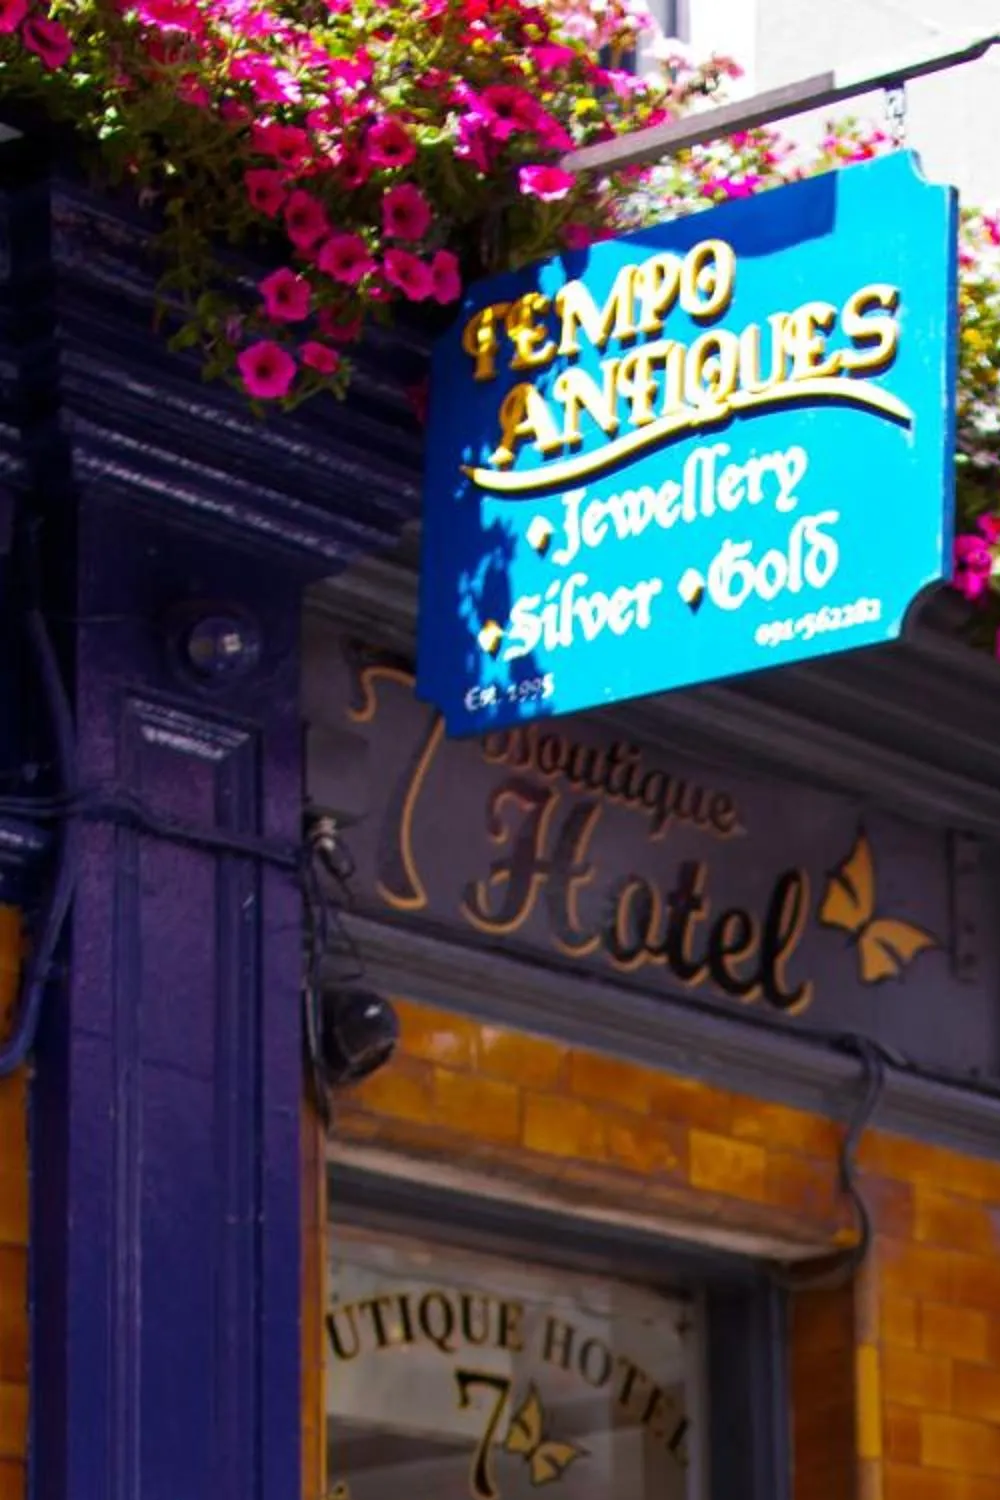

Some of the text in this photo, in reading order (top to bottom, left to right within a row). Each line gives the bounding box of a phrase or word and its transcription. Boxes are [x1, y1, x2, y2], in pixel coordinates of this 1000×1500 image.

[461, 238, 736, 380] TEMPO
[488, 283, 900, 464] ANTIQUES
[552, 443, 808, 567] Jewellery
[503, 510, 841, 661] Silver Gold
[463, 776, 813, 1016] Hotel
